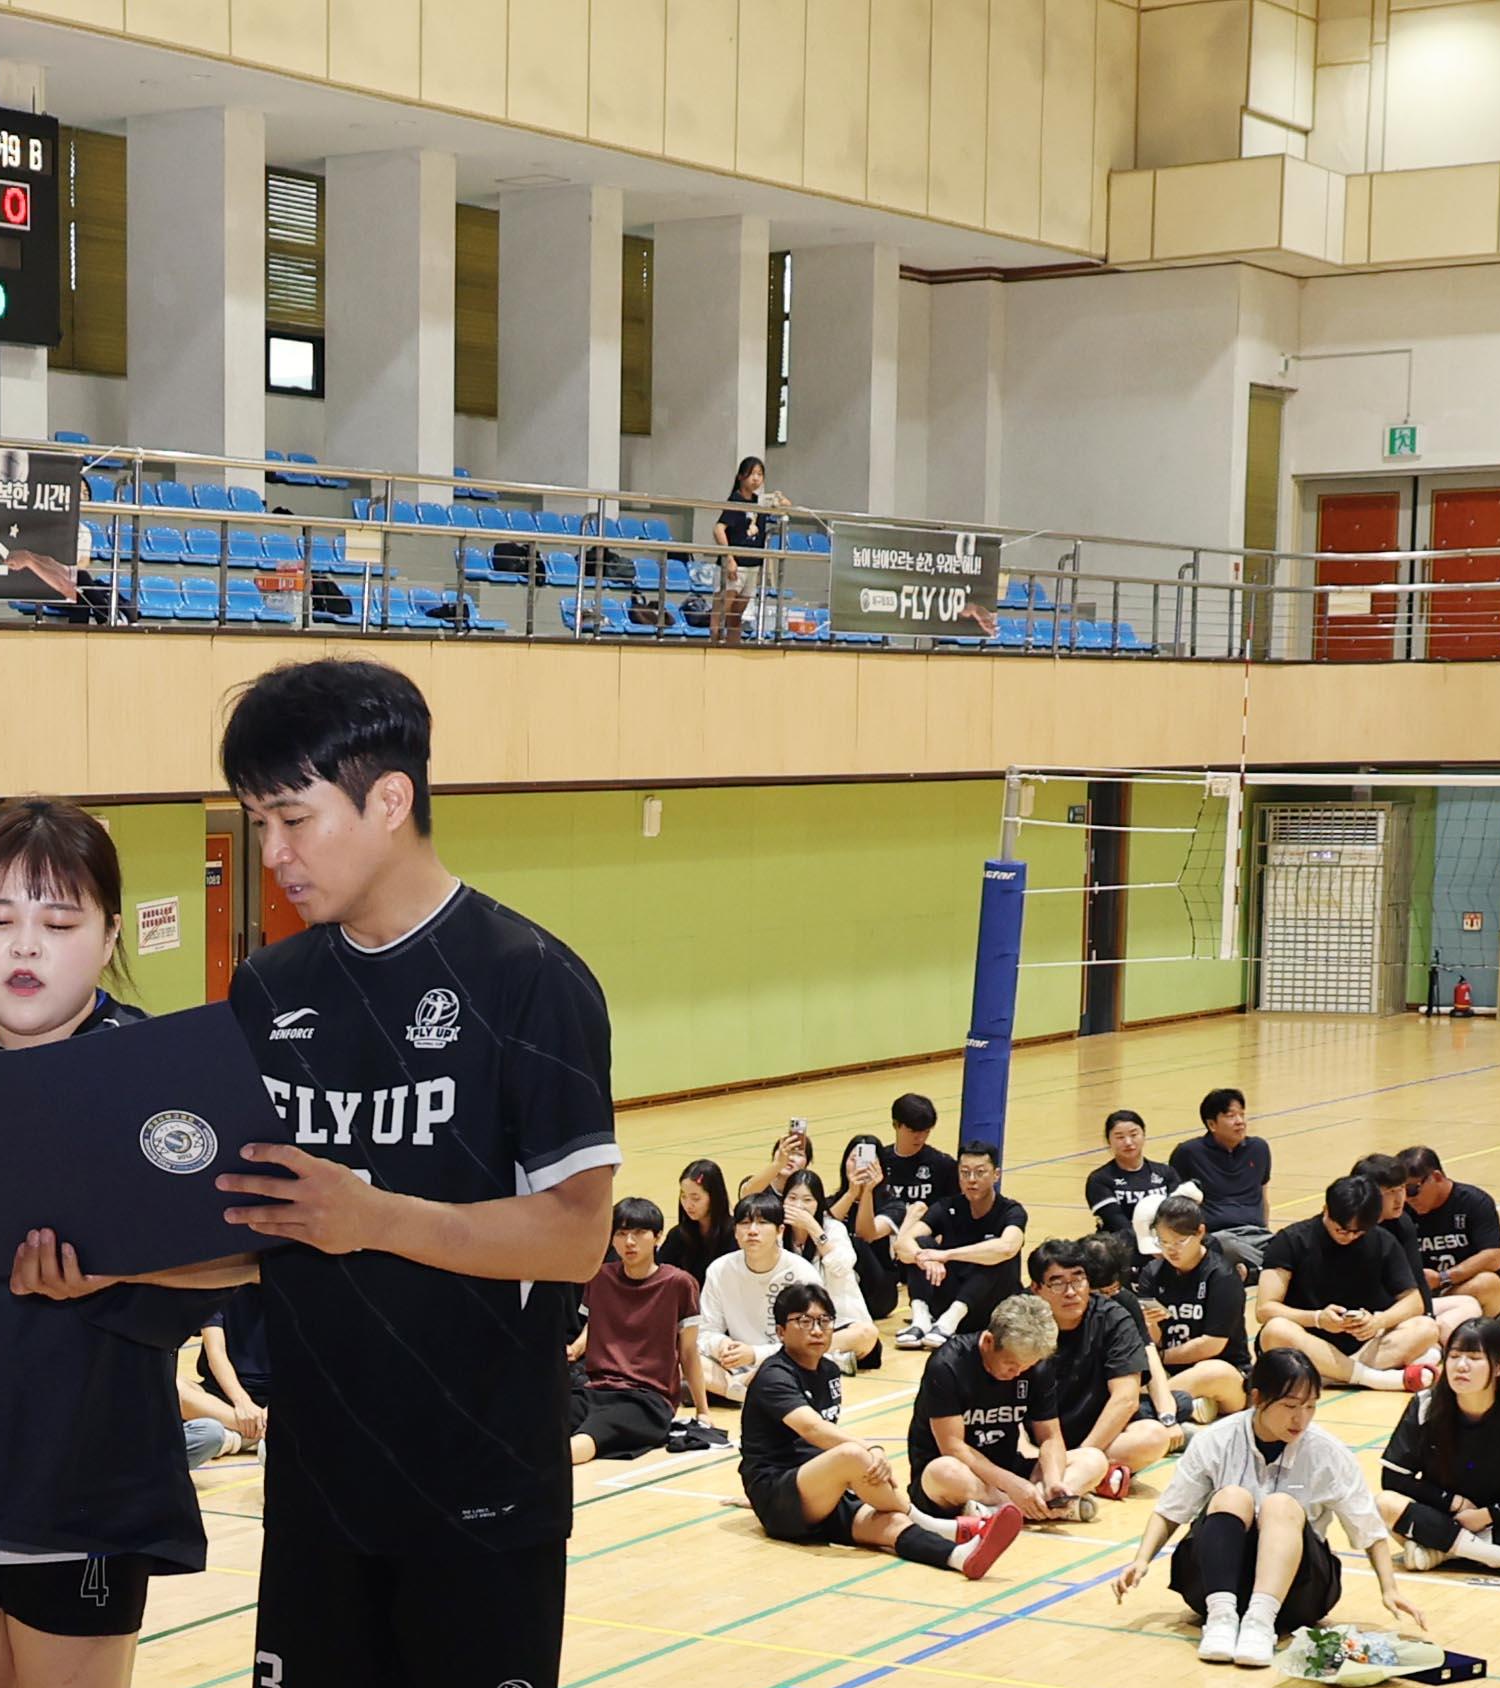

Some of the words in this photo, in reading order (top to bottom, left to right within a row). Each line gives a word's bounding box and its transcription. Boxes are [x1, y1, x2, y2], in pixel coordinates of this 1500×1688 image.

[29, 139, 43, 171] B
[3, 187, 27, 225] 0
[33, 482, 71, 512] 시간!
[900, 585, 936, 620] FLY
[939, 587, 966, 621] UP
[269, 1027, 315, 1041] DENFORCE
[412, 1026, 433, 1039] FLY
[435, 1026, 451, 1039] UP
[372, 1075, 456, 1146] UP
[80, 1556, 109, 1607] 4
